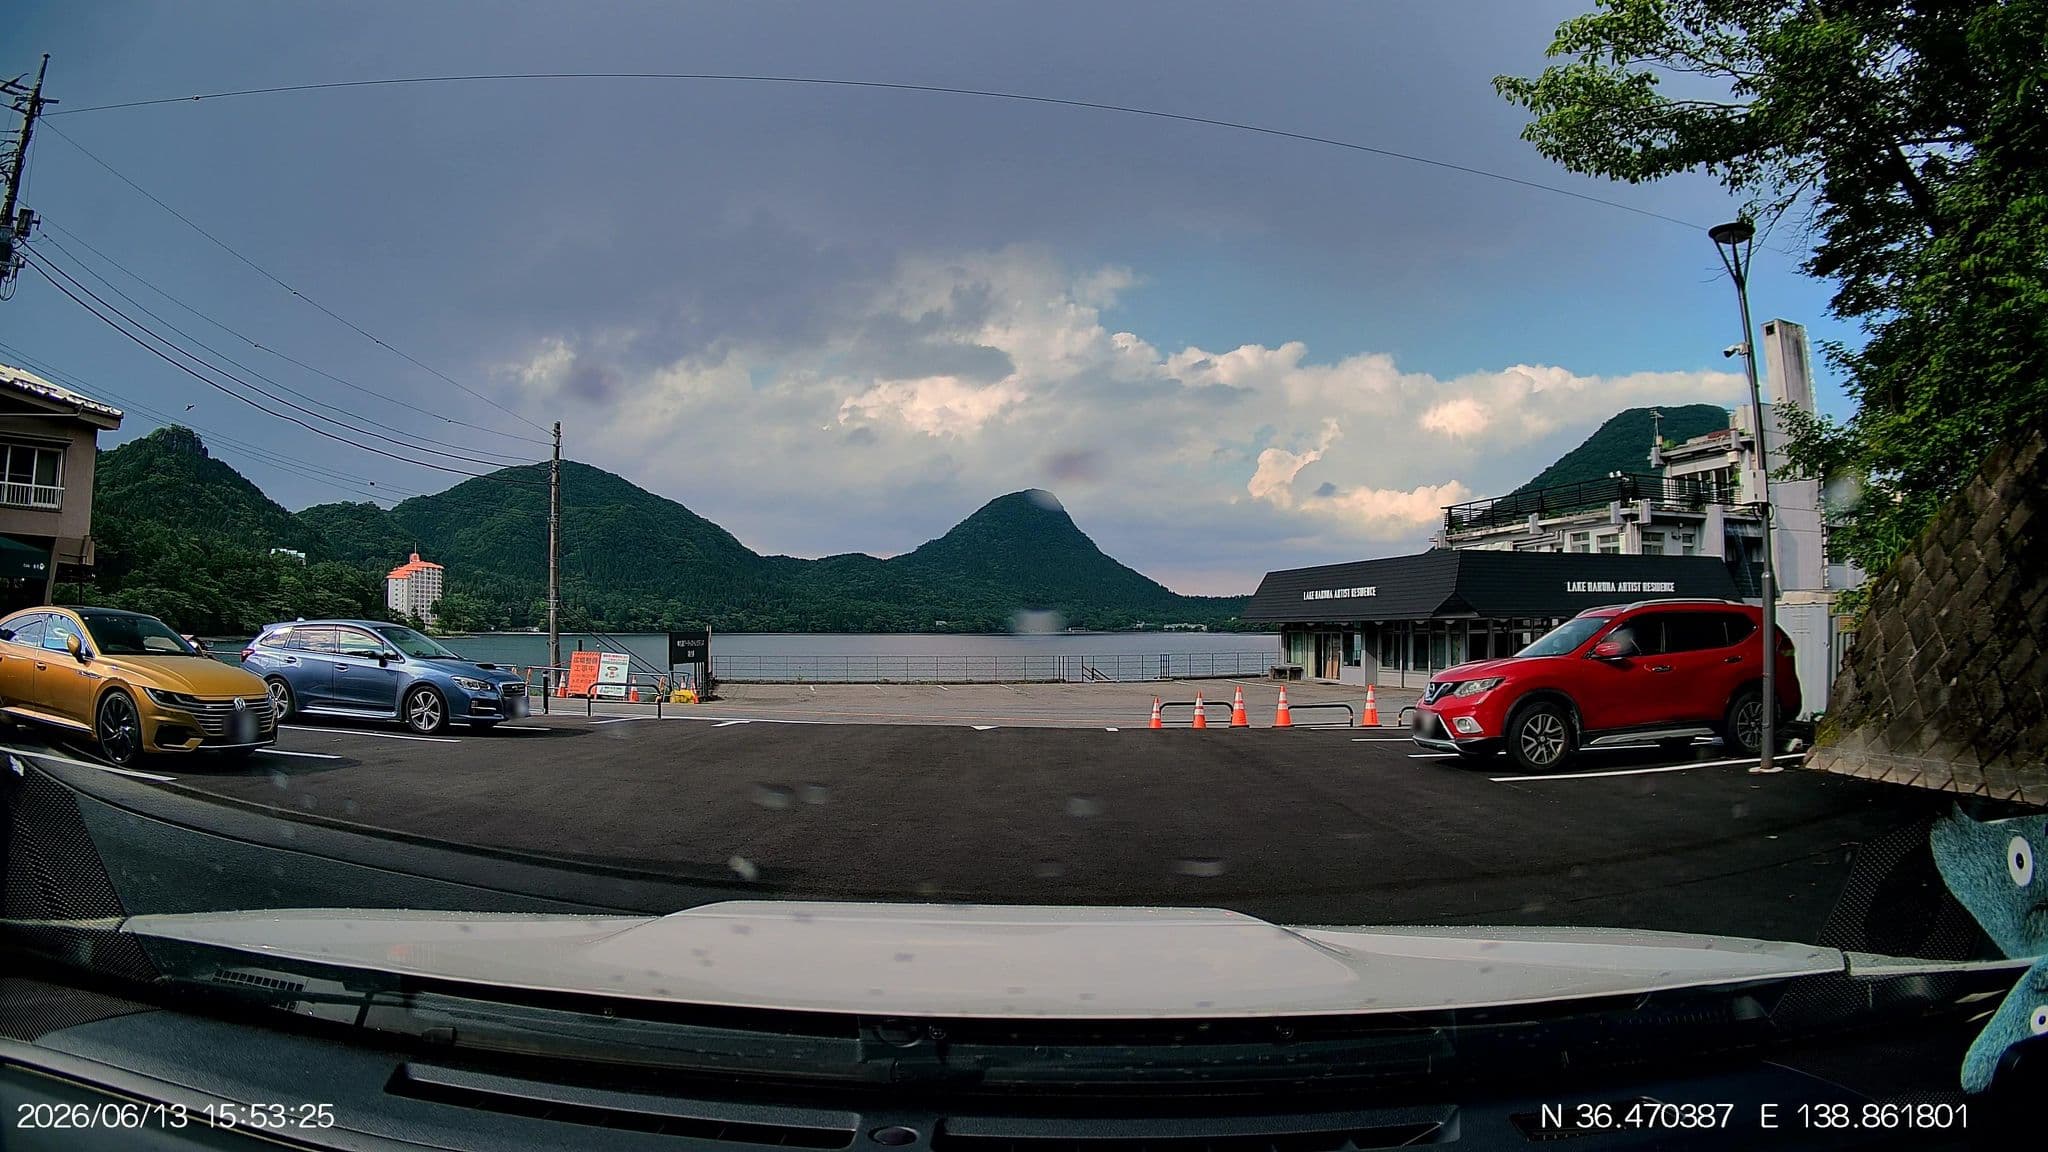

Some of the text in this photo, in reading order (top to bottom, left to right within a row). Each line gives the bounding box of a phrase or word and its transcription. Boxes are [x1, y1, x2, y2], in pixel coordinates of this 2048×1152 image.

[1567, 581, 1587, 592] LAKE
[1618, 581, 1642, 593] ARTIST
[1643, 581, 1675, 593] RESIDENCE
[1303, 591, 1315, 600] LAKE
[1334, 588, 1350, 599] ARTIST
